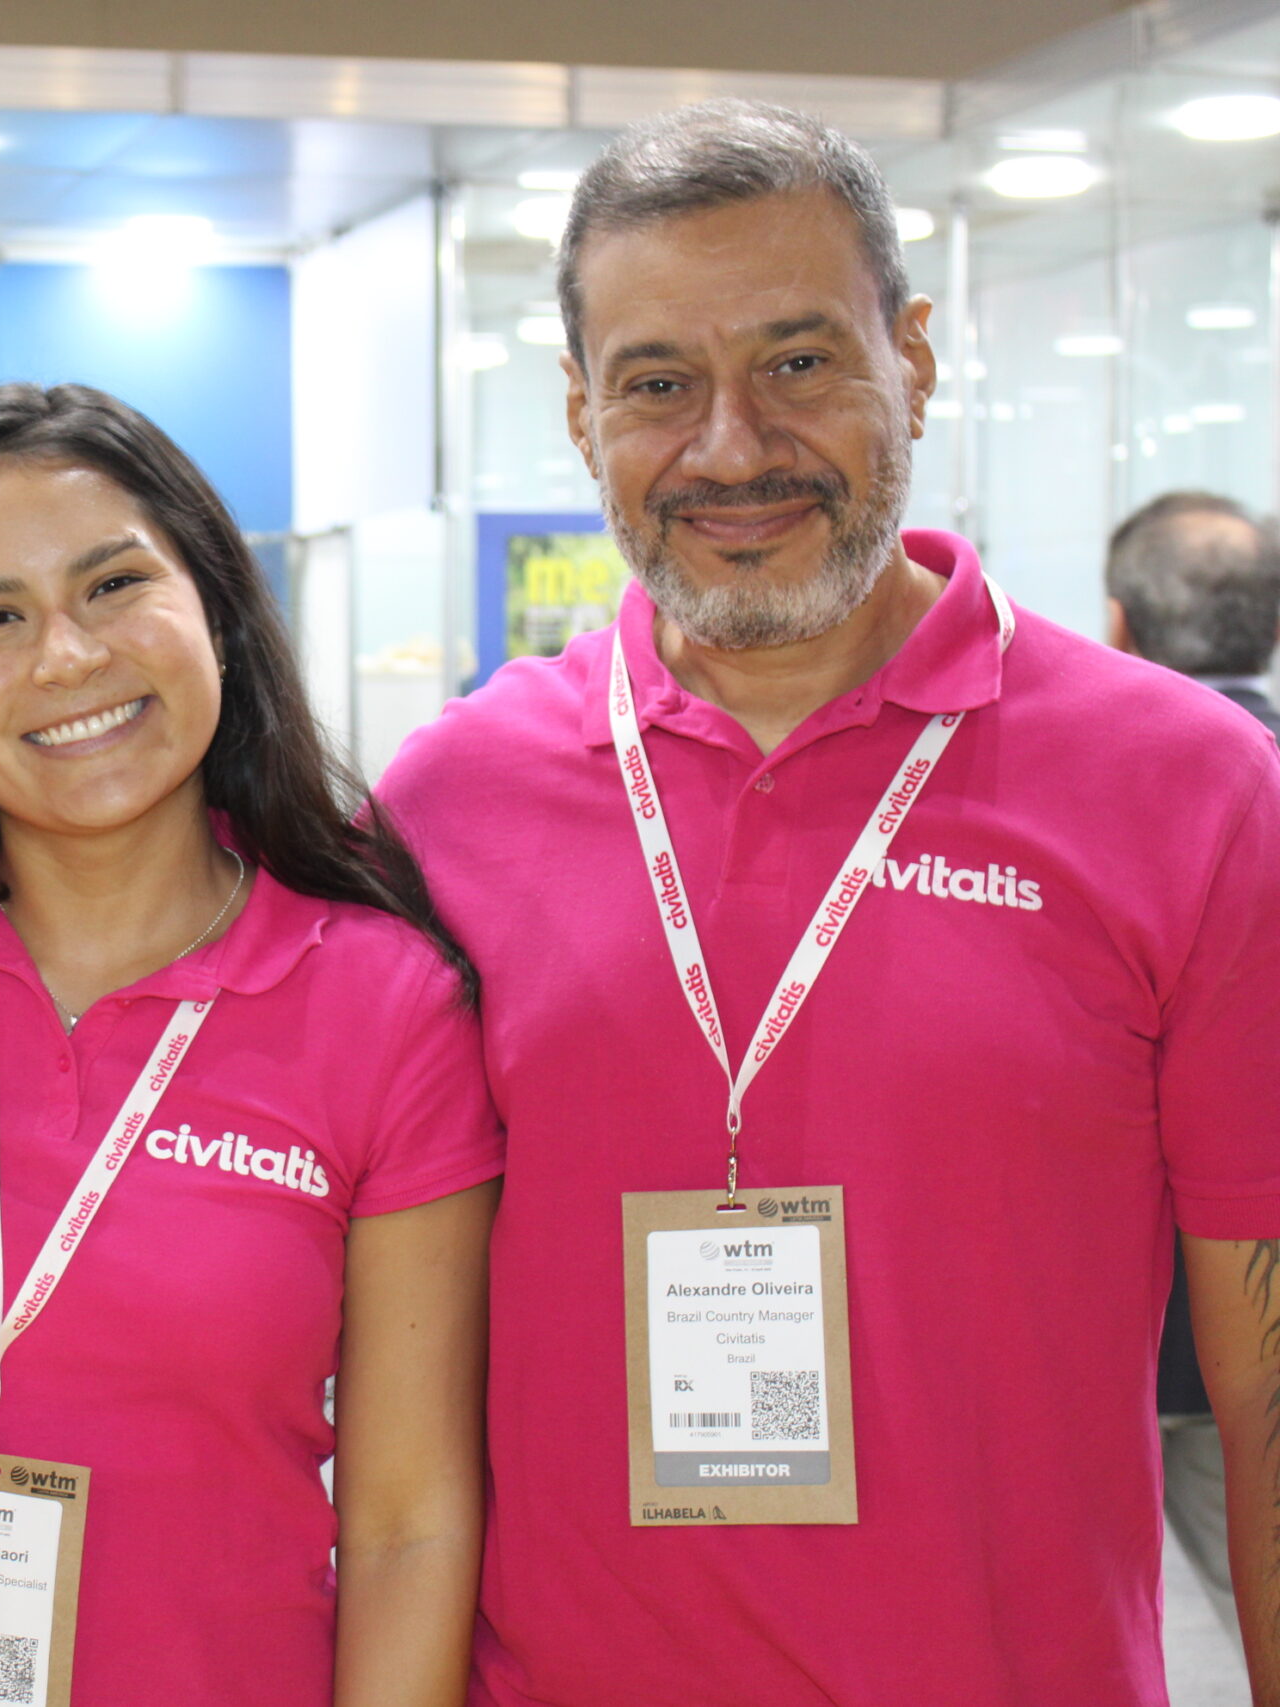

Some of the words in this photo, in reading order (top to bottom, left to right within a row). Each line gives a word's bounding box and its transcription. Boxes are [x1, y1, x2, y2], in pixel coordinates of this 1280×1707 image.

[624, 745, 656, 820] civitatis
[878, 758, 931, 835] civitatis
[652, 851, 687, 930] civitatis
[816, 866, 868, 947] civitatis
[872, 853, 1043, 911] ivitatis
[685, 963, 721, 1047] civitatis
[754, 980, 806, 1062] civitatis
[149, 1033, 189, 1092] civitatis
[105, 1111, 145, 1171] civitatis
[145, 1124, 330, 1198] civitatis
[60, 1190, 100, 1252] civitatis
[781, 1196, 831, 1214] wtm
[723, 1240, 773, 1257] wtm
[13, 1272, 56, 1330] civitatis
[666, 1282, 747, 1297] Alexandre
[751, 1281, 814, 1296] Oliveira
[667, 1310, 702, 1323] Brazil
[705, 1309, 755, 1325] Country
[758, 1309, 815, 1325] Manager
[716, 1332, 766, 1345] Civitatis
[727, 1353, 756, 1365] Brazil
[31, 1470, 76, 1491] wtm
[699, 1464, 791, 1477] EXHIBITOR
[642, 1507, 706, 1520] ILHABELA
